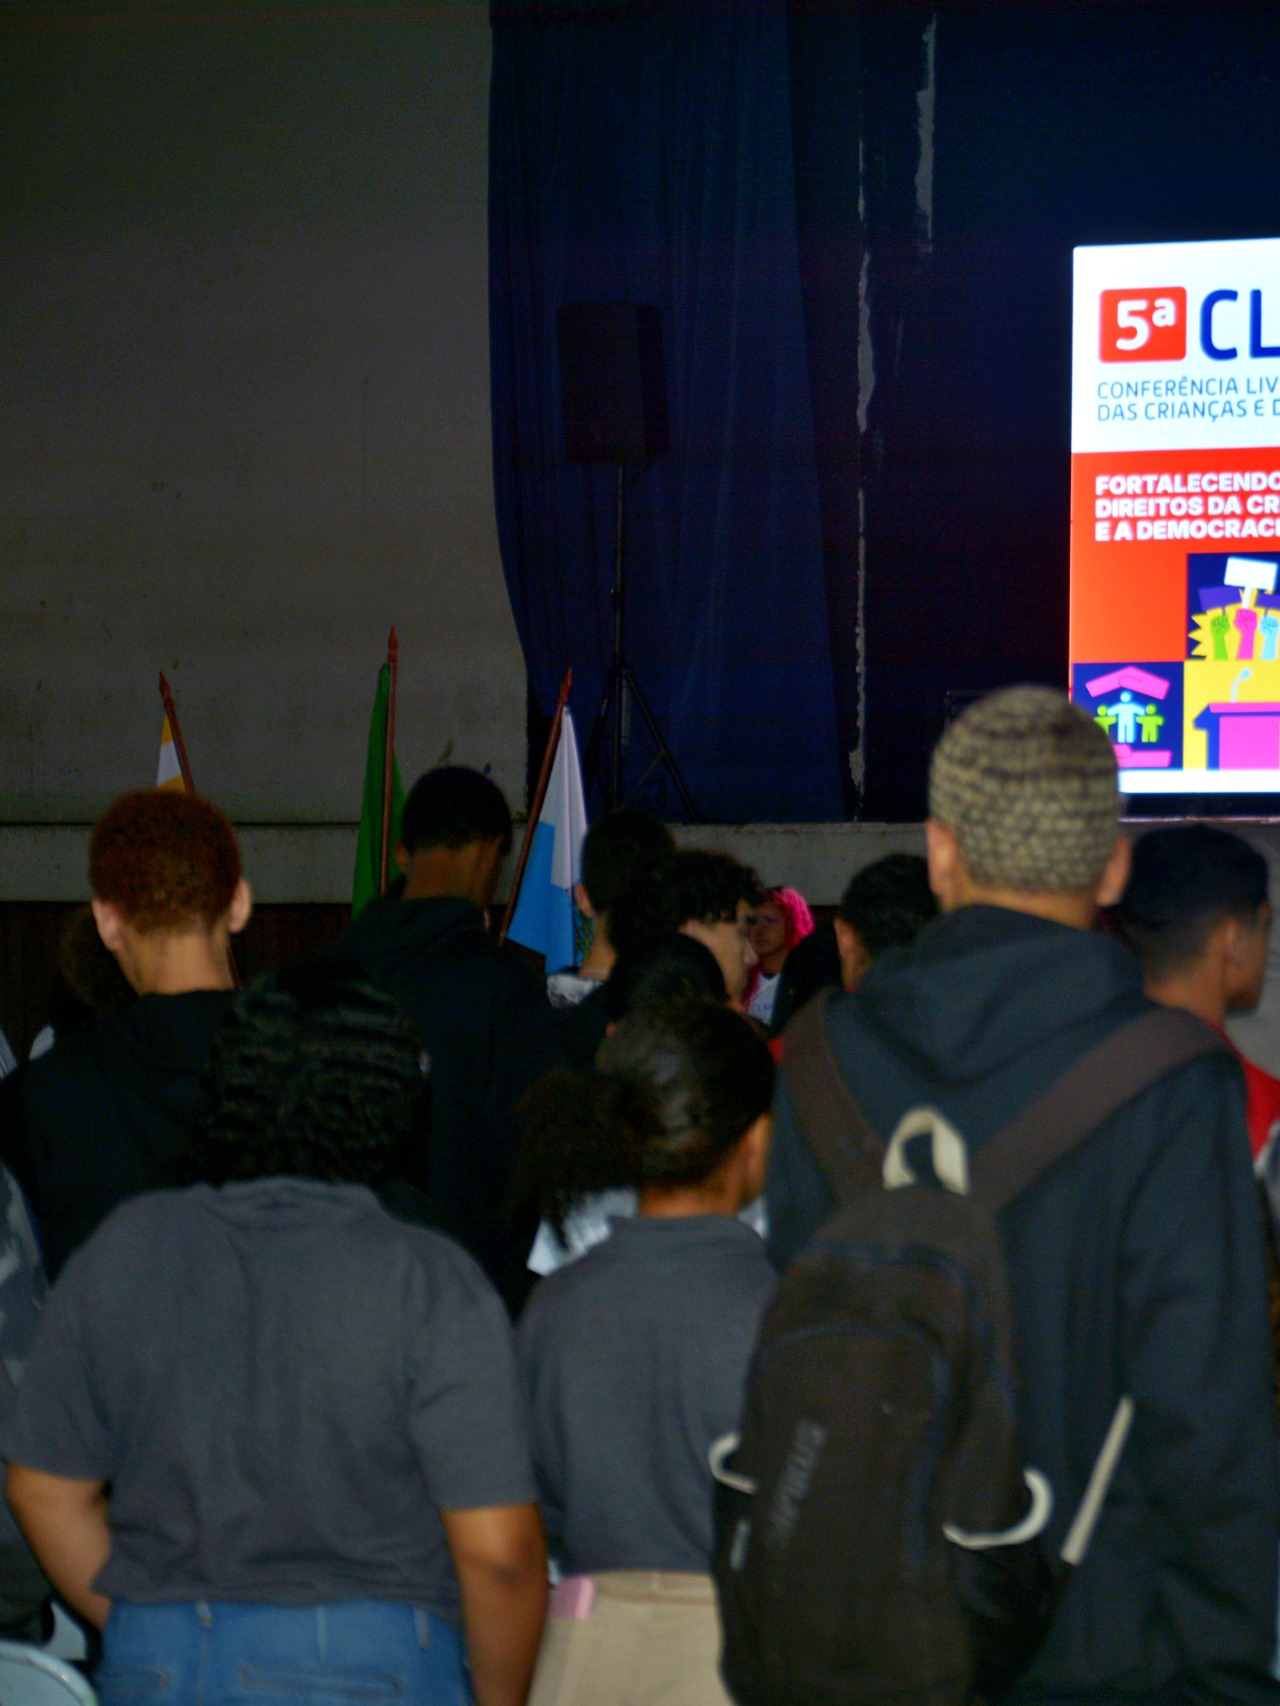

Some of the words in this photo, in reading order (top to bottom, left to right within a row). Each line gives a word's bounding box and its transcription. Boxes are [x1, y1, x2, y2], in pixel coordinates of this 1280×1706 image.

[1097, 375, 1239, 400] CONFERÊNCIA
[1097, 402, 1138, 422] DAS
[1144, 398, 1248, 424] CRIANÇAS
[1253, 398, 1265, 417] E
[1095, 495, 1204, 519] DIREITOS
[1207, 495, 1243, 516] DA
[1095, 520, 1111, 542] E
[1113, 520, 1134, 541] A
